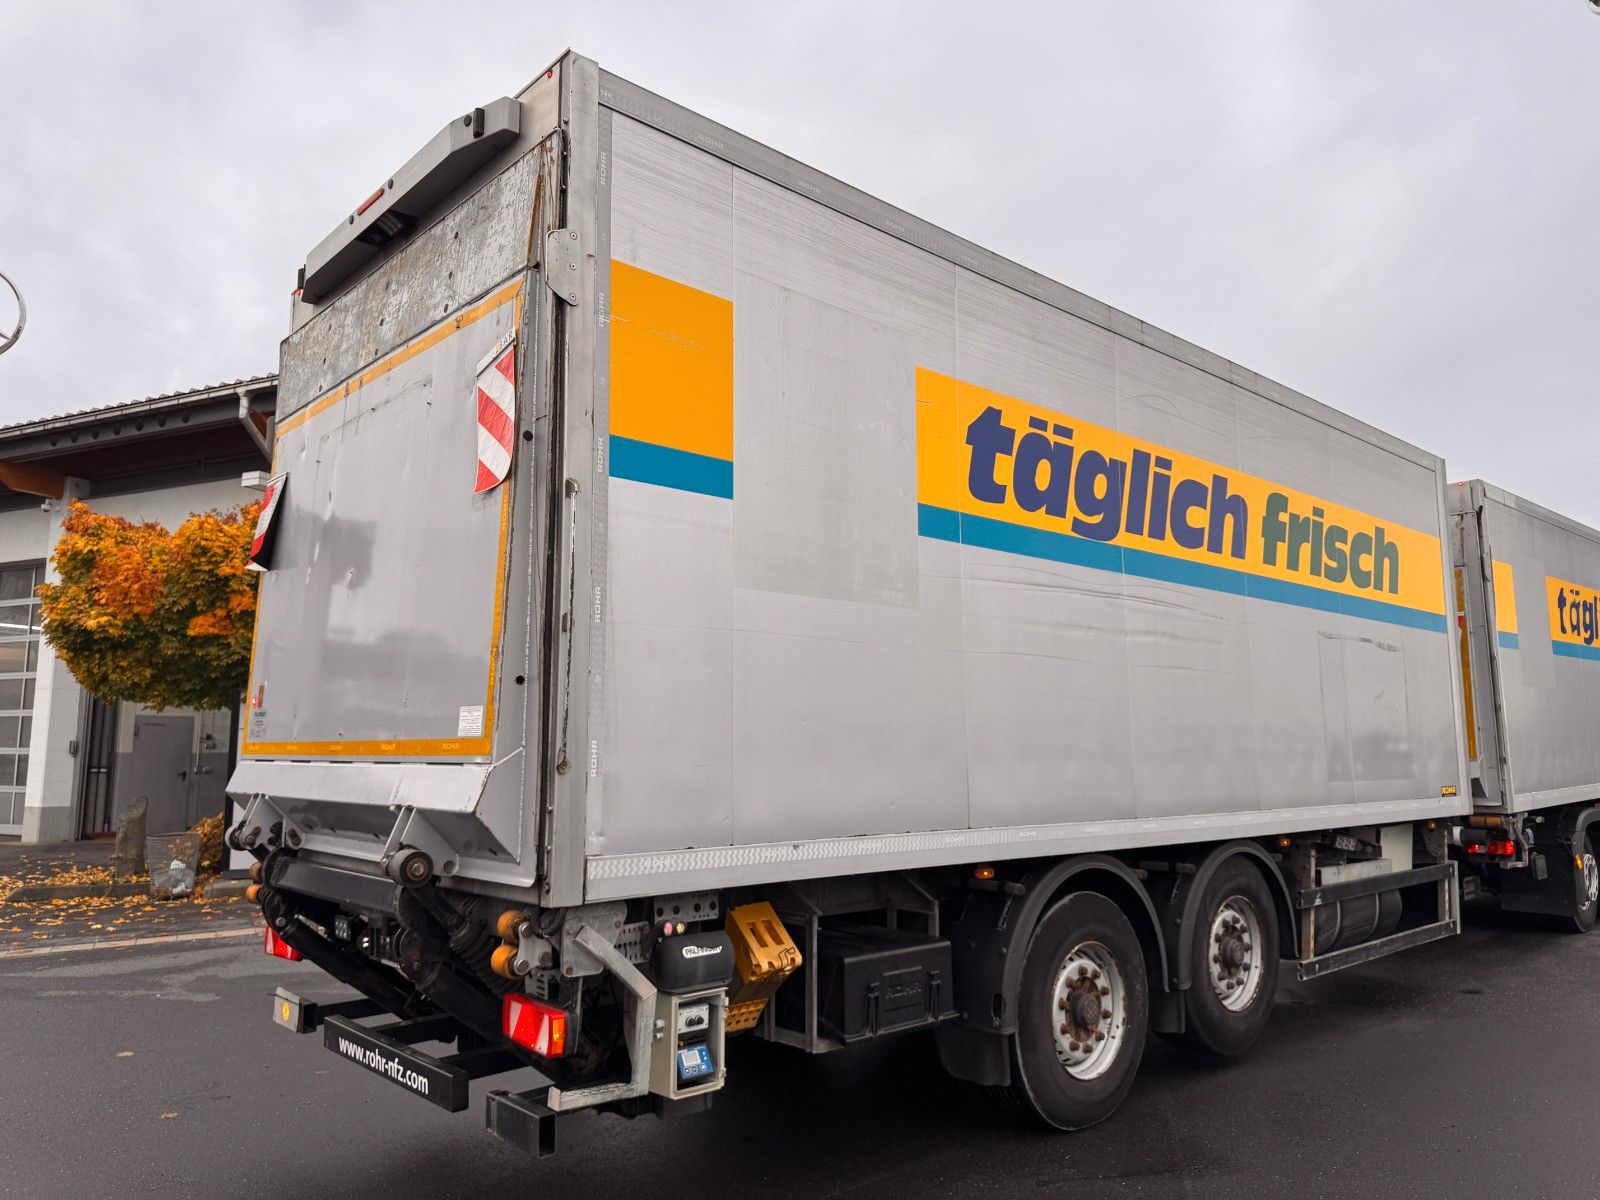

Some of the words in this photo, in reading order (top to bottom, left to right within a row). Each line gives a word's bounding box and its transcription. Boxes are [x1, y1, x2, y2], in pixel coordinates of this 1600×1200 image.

[965, 405, 1249, 560] täglich
[1261, 492, 1399, 595] frisch
[1557, 587, 1600, 645] tägl
[590, 739, 598, 777] ROHR
[338, 1037, 429, 1095] www.rohr-nfz.com
